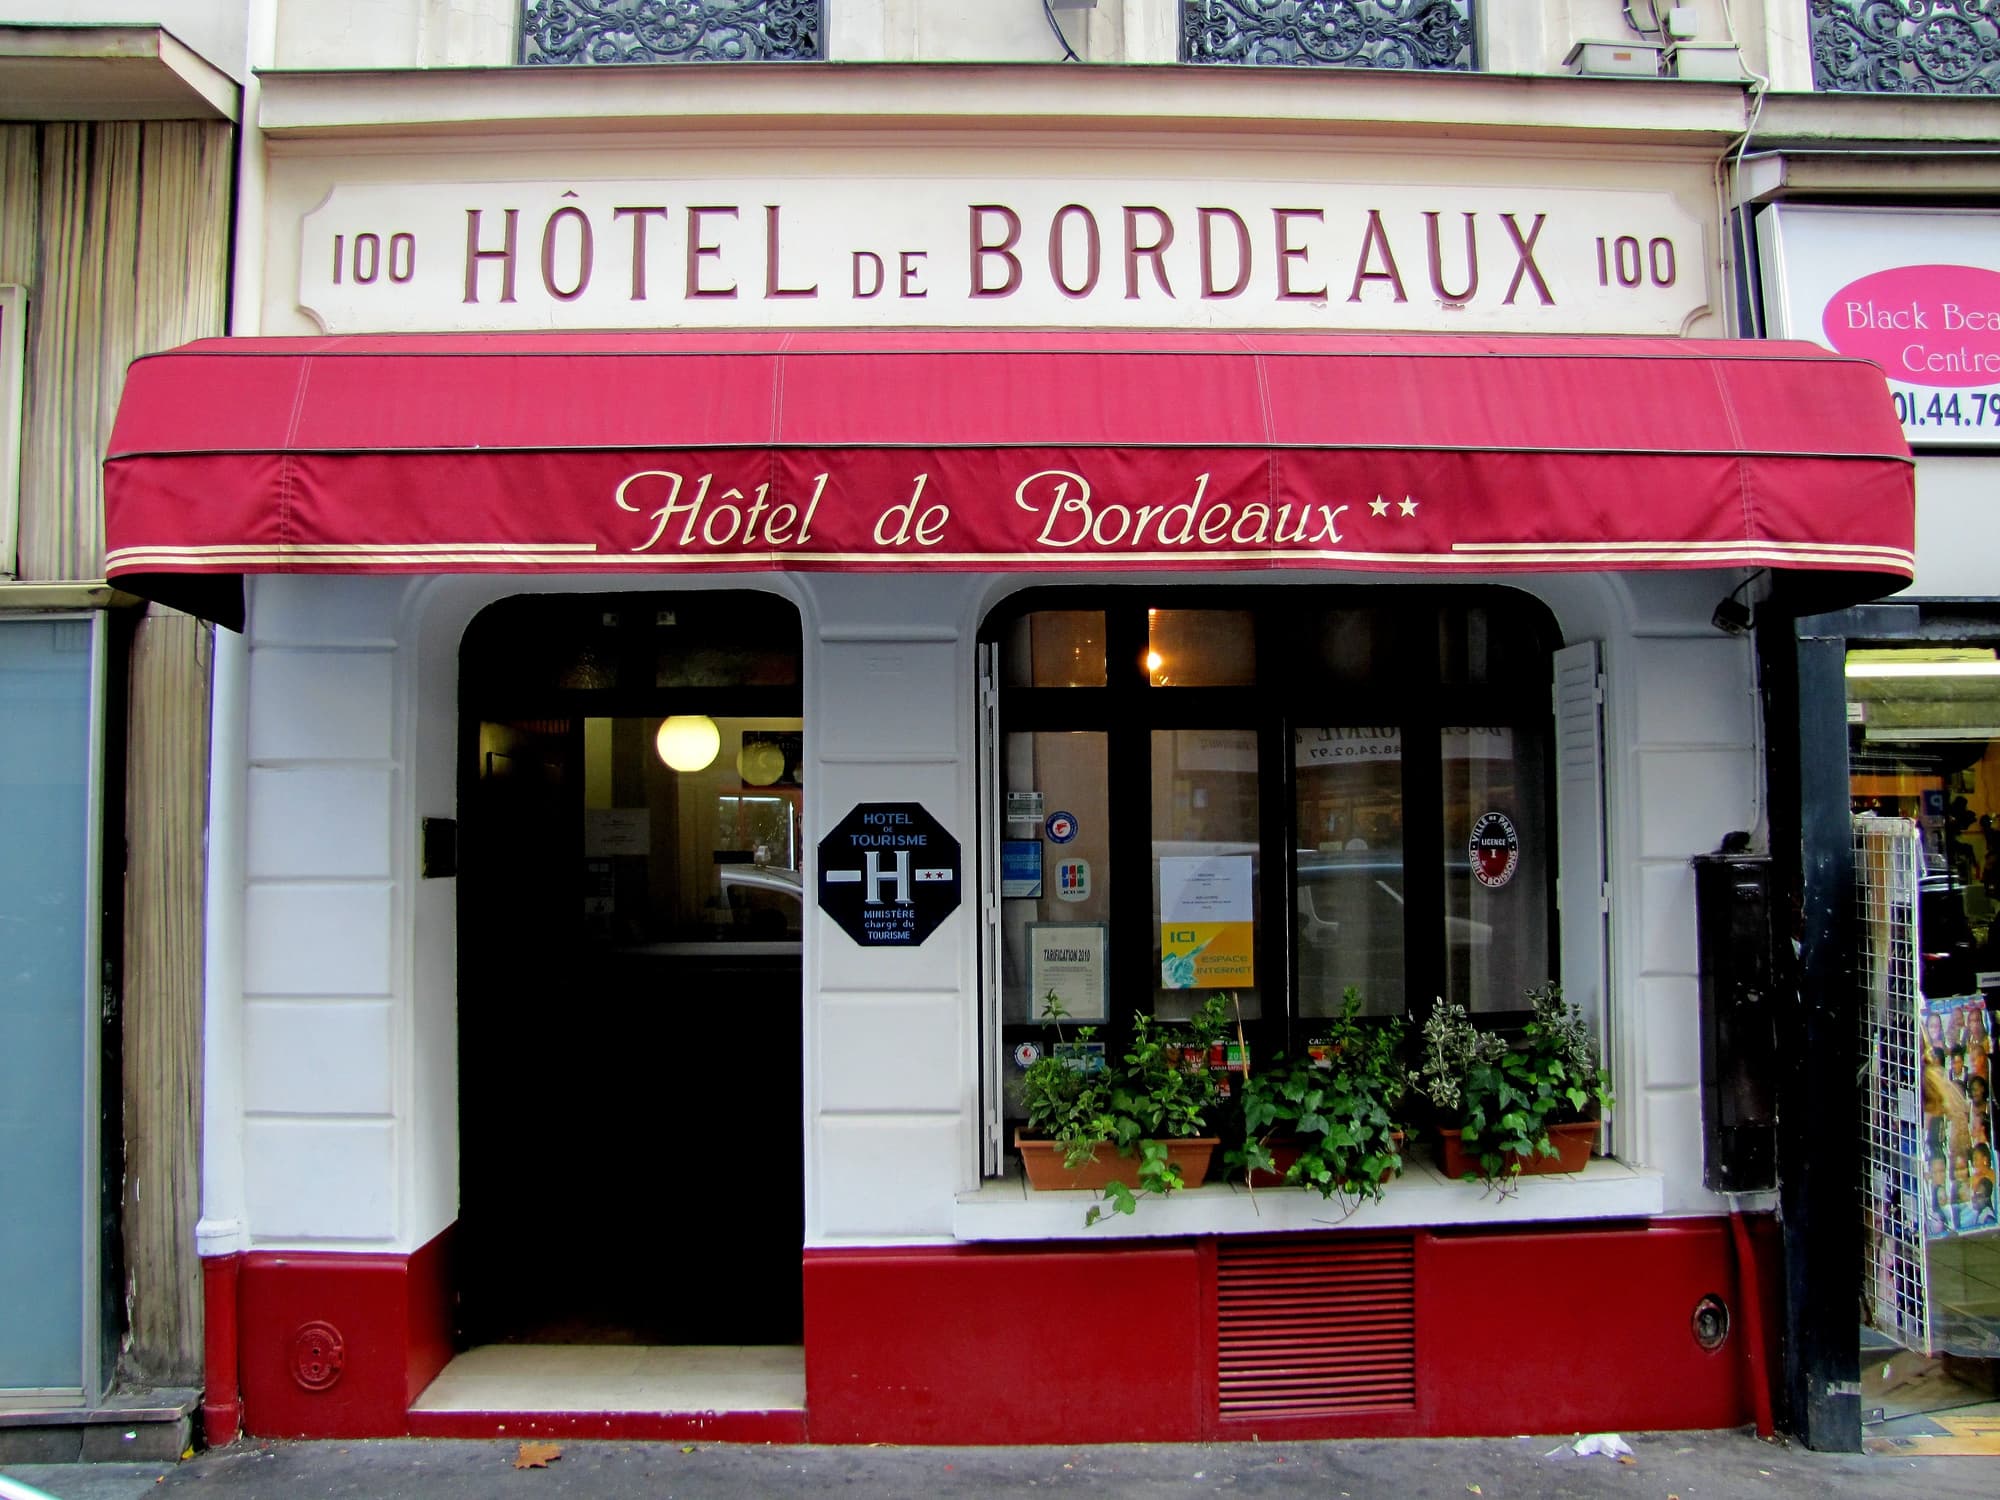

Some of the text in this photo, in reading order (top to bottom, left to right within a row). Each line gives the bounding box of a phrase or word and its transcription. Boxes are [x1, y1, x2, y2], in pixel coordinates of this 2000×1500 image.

[333, 231, 416, 285] 100
[462, 190, 1556, 306] HÔTEL DE BORDEAUX
[1595, 235, 1677, 288] 100
[1844, 300, 2000, 332] Black Bea
[1902, 343, 2000, 373] Centre
[615, 470, 1349, 551] Hôtel de Bordeaux
[863, 813, 914, 825] HOTEL
[1471, 817, 1489, 842] VILLE
[1498, 816, 1516, 843] PARIS
[849, 834, 928, 846] TOURISME
[1481, 838, 1506, 846] LICENCE
[864, 850, 915, 905] H
[1488, 851, 1517, 885] BOISSONS
[864, 919, 914, 930] chargé du
[867, 930, 911, 940] TOURISME
[1170, 930, 1196, 943] ICI
[1043, 949, 1091, 962] TARIFICATION 2010
[1202, 955, 1248, 963] ESPACE
[1197, 967, 1251, 975] INTERNET
